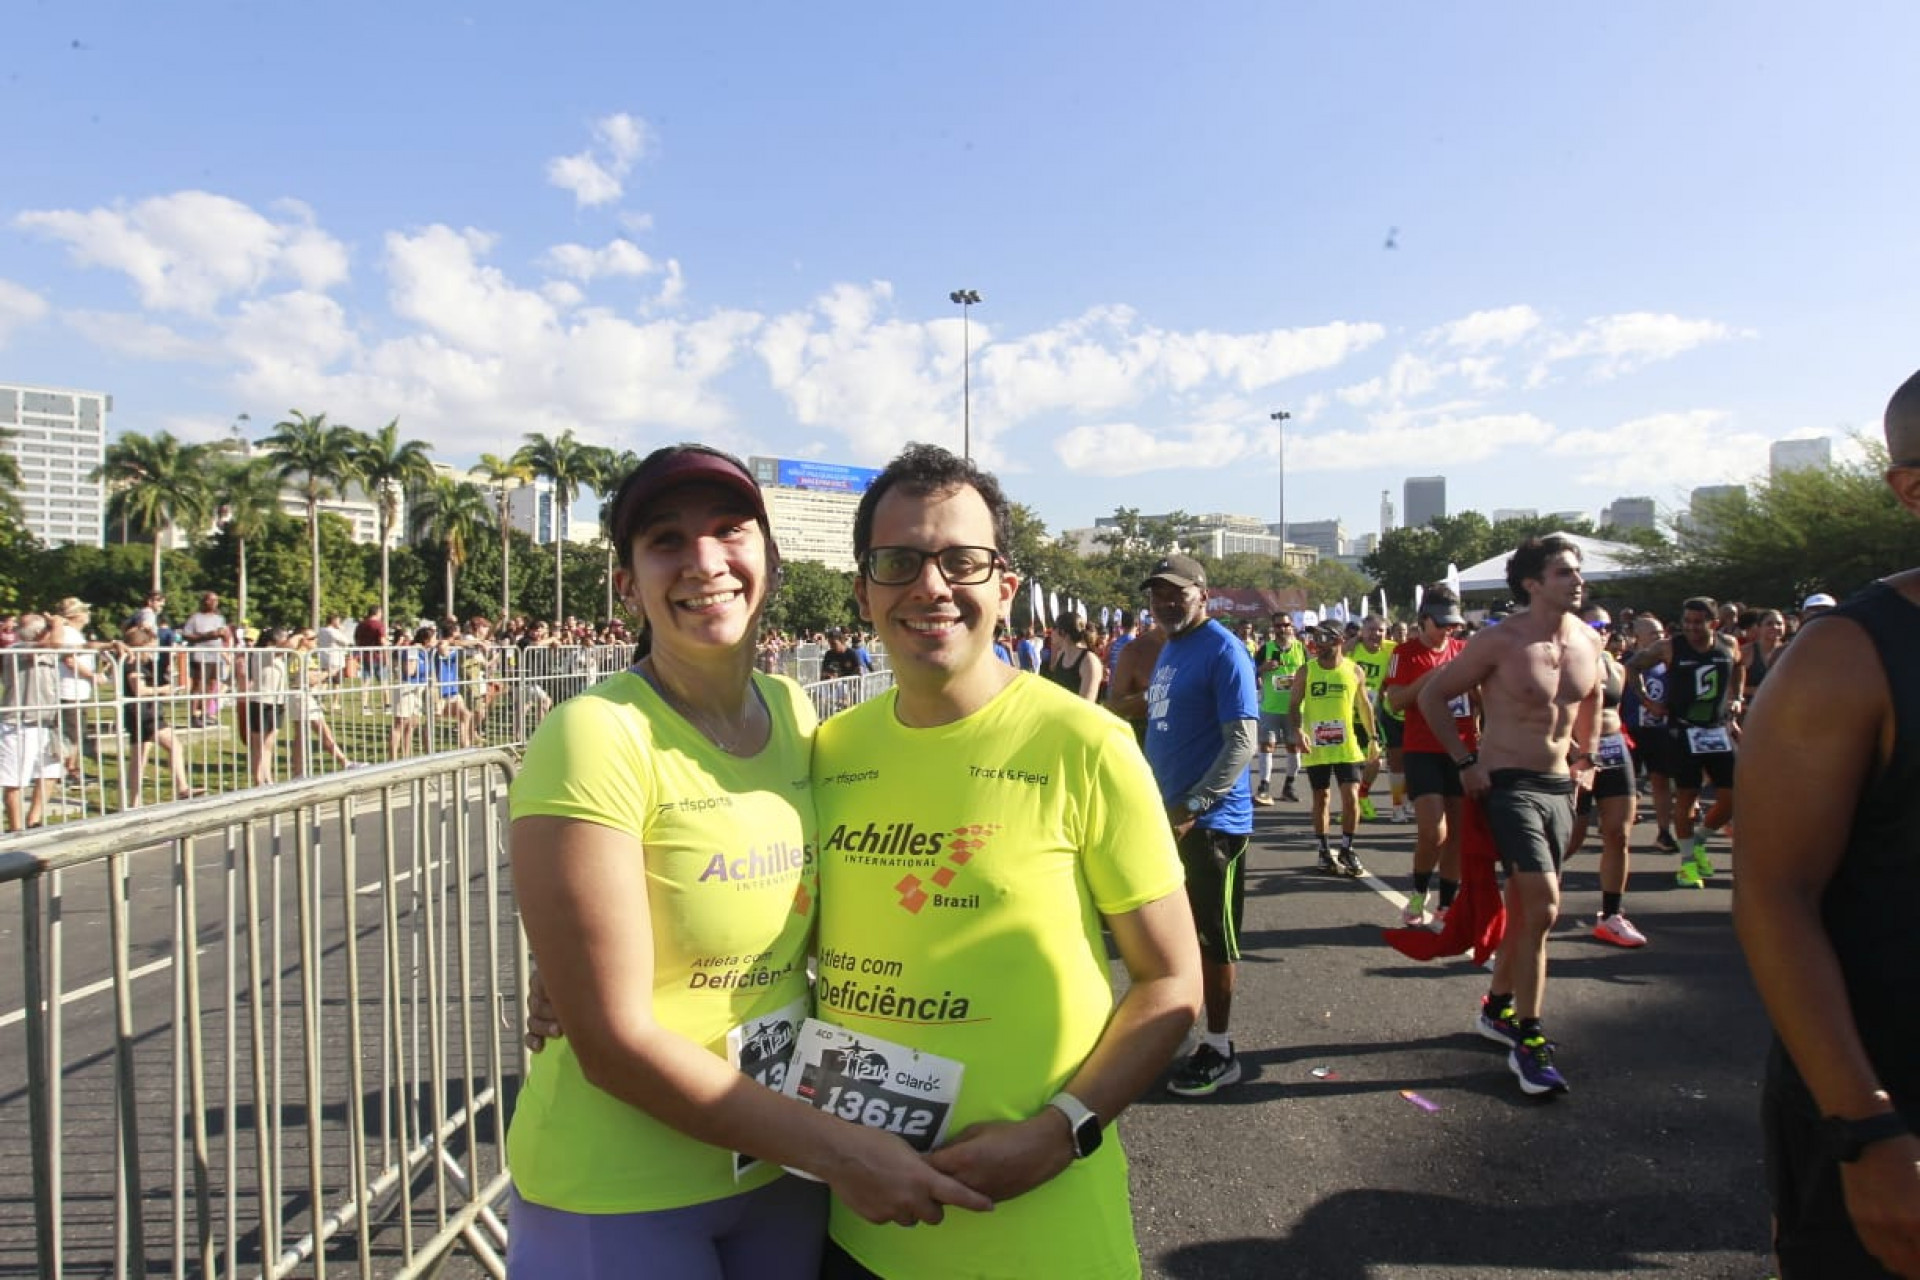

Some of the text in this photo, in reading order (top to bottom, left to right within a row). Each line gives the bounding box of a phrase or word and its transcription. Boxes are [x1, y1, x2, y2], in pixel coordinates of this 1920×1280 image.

[824, 822, 945, 856] Achilles
[699, 842, 813, 882] Achilles
[845, 855, 937, 867] INTERNATIONAL
[933, 893, 980, 909] Brazil
[690, 954, 739, 968] Atleta
[861, 958, 903, 978] com
[820, 976, 970, 1021] Deficiência
[896, 1072, 933, 1091] Claro
[821, 1086, 934, 1136] 13612
